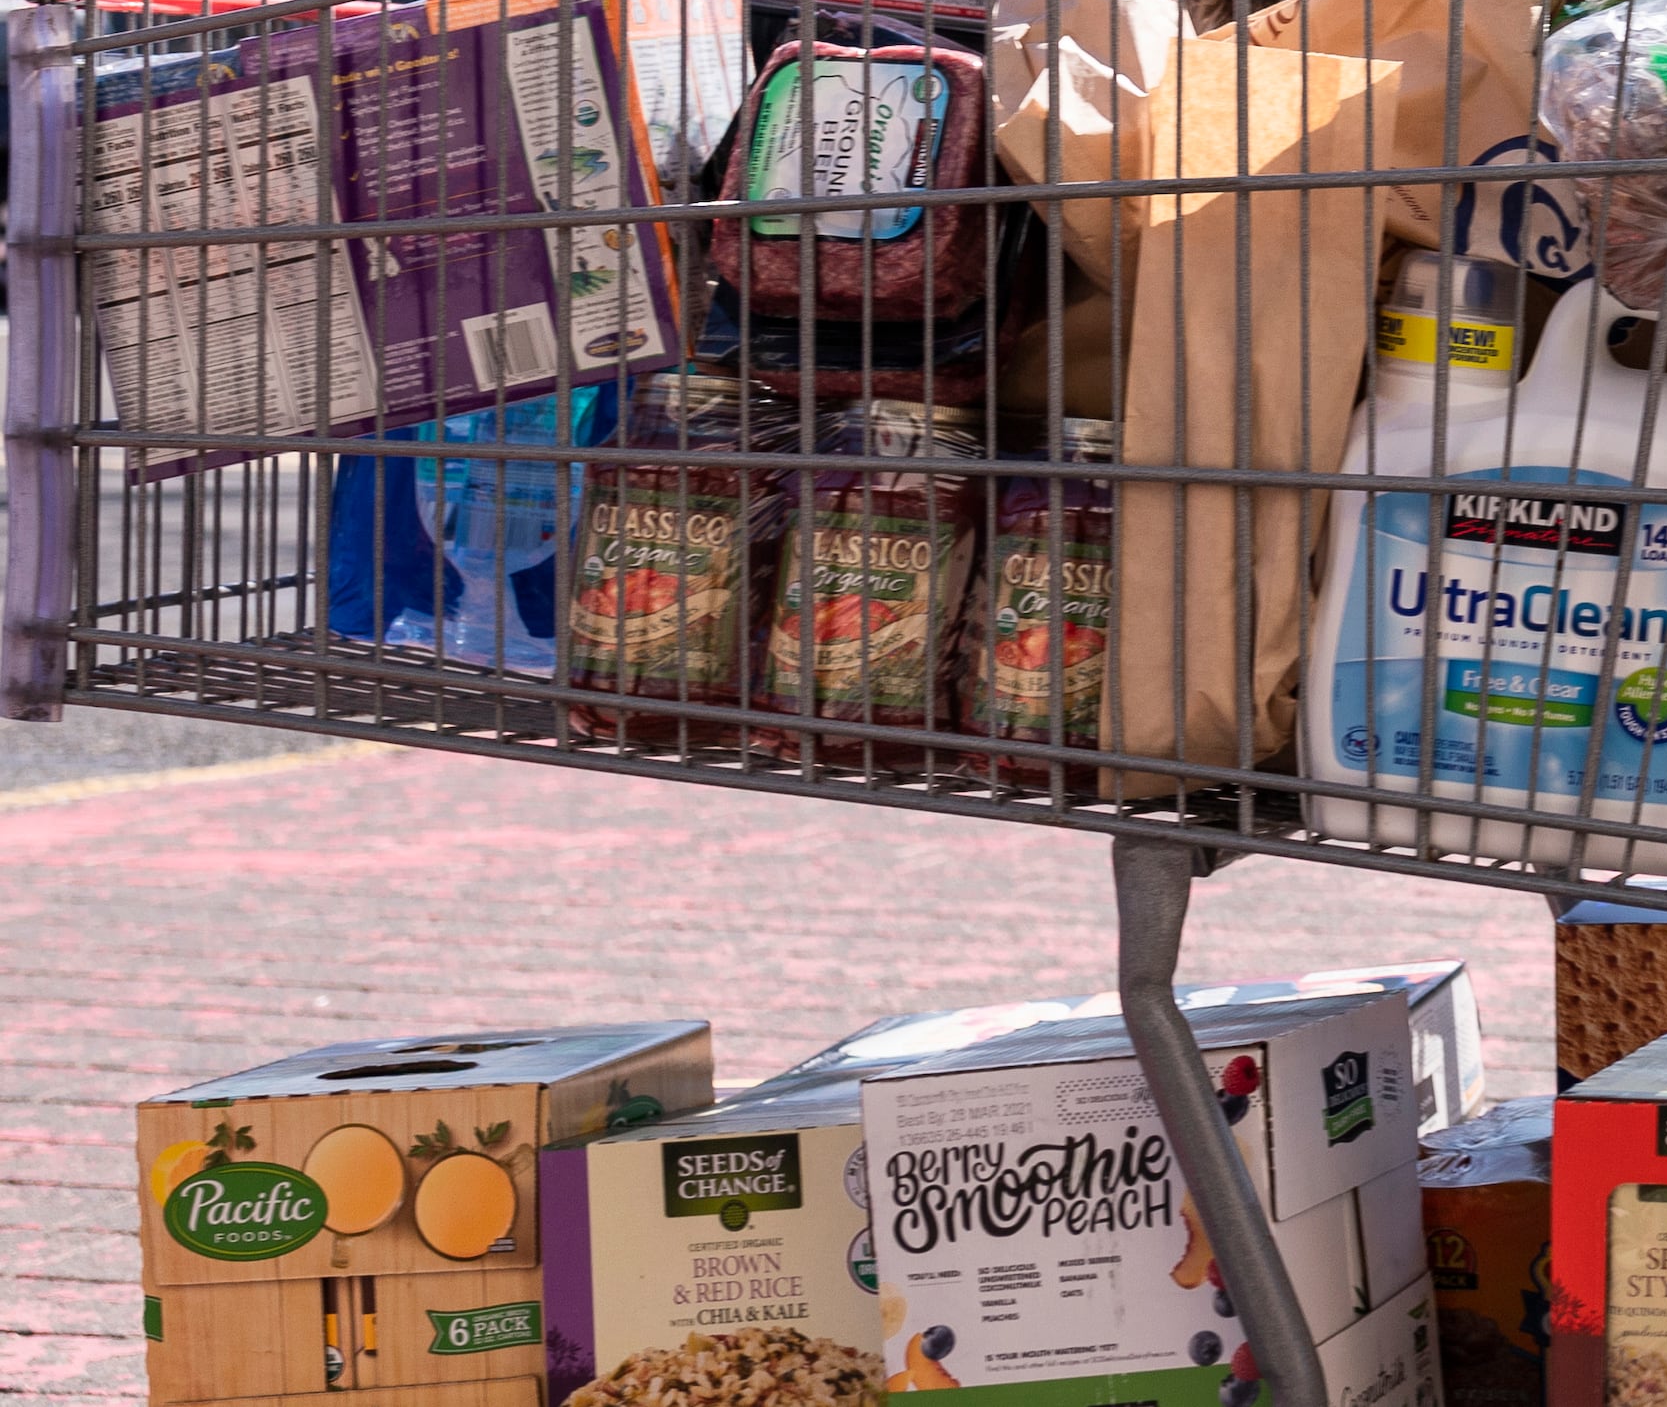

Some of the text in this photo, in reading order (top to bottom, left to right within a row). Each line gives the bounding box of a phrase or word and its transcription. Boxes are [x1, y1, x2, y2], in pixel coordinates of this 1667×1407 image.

[1508, 674, 1525, 693] &
[677, 1148, 787, 1178] SEEDS of
[887, 1142, 1005, 1207] Berry
[678, 1173, 787, 1200] CHANGE
[893, 1126, 1172, 1255] Smoothie
[179, 1179, 316, 1232] Pacific
[213, 1231, 283, 1243] FOODS
[1431, 1235, 1466, 1269] 12
[692, 1252, 782, 1279] BROWN
[672, 1276, 805, 1306] & RED RICE
[696, 1307, 744, 1326] CHIA
[745, 1305, 761, 1322] &
[762, 1302, 810, 1321] KALE
[448, 1317, 470, 1347] 6
[472, 1315, 531, 1338] PACK
